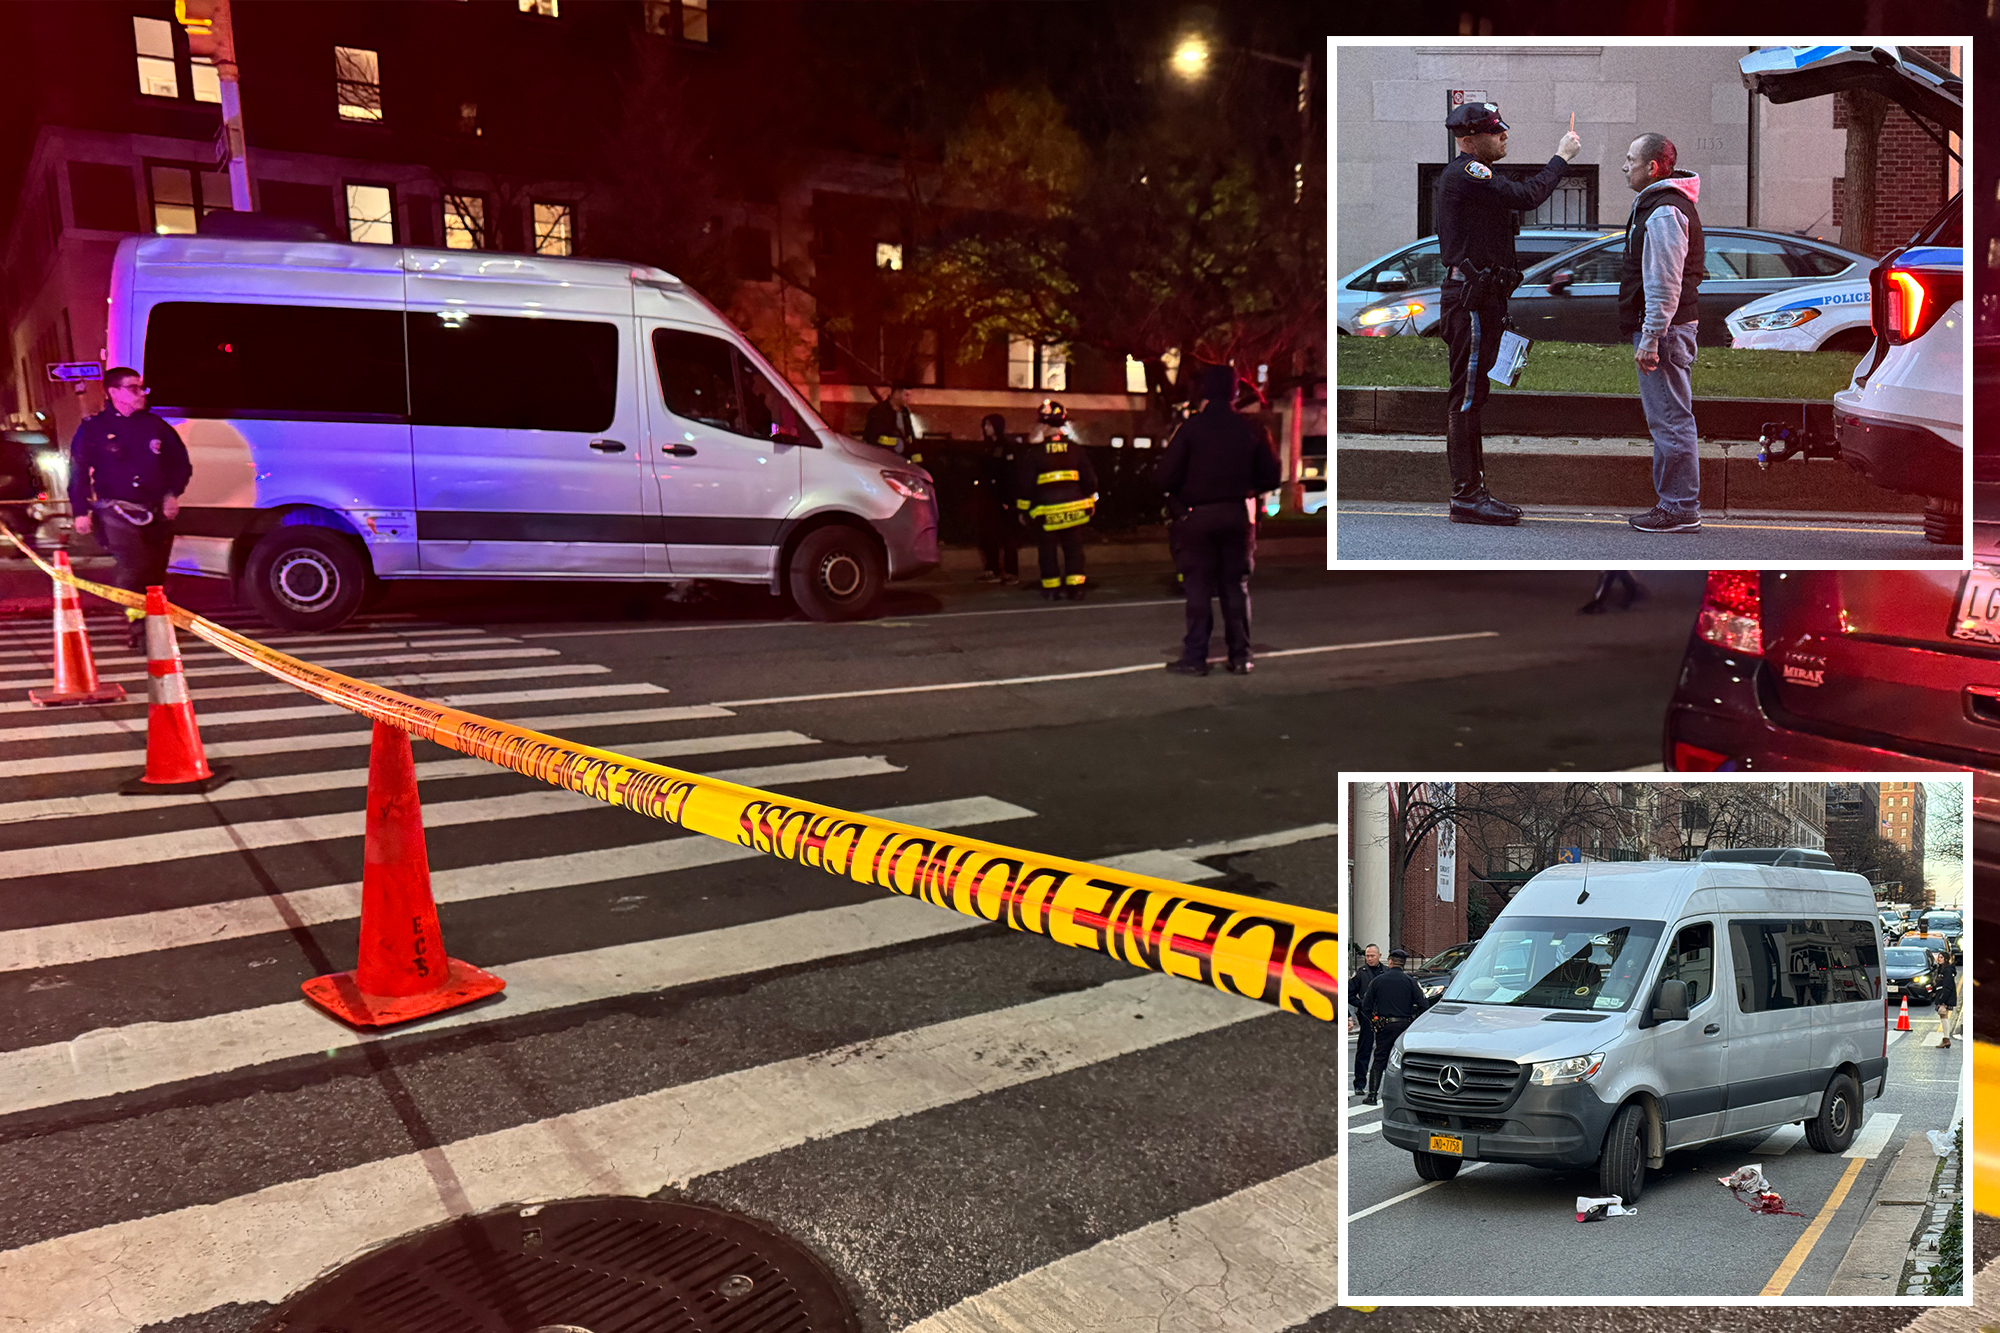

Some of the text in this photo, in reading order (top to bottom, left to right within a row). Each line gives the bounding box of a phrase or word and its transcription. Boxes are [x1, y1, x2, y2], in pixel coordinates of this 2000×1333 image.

[1824, 292, 1870, 305] POLICE
[1046, 442, 1068, 453] FDNY
[1783, 664, 1824, 685] MIRAK
[454, 721, 504, 766] CROSS
[549, 750, 625, 803] SCENE
[609, 768, 698, 827] CRIME
[737, 800, 1338, 1022] SCENE DO NOT CROSS
